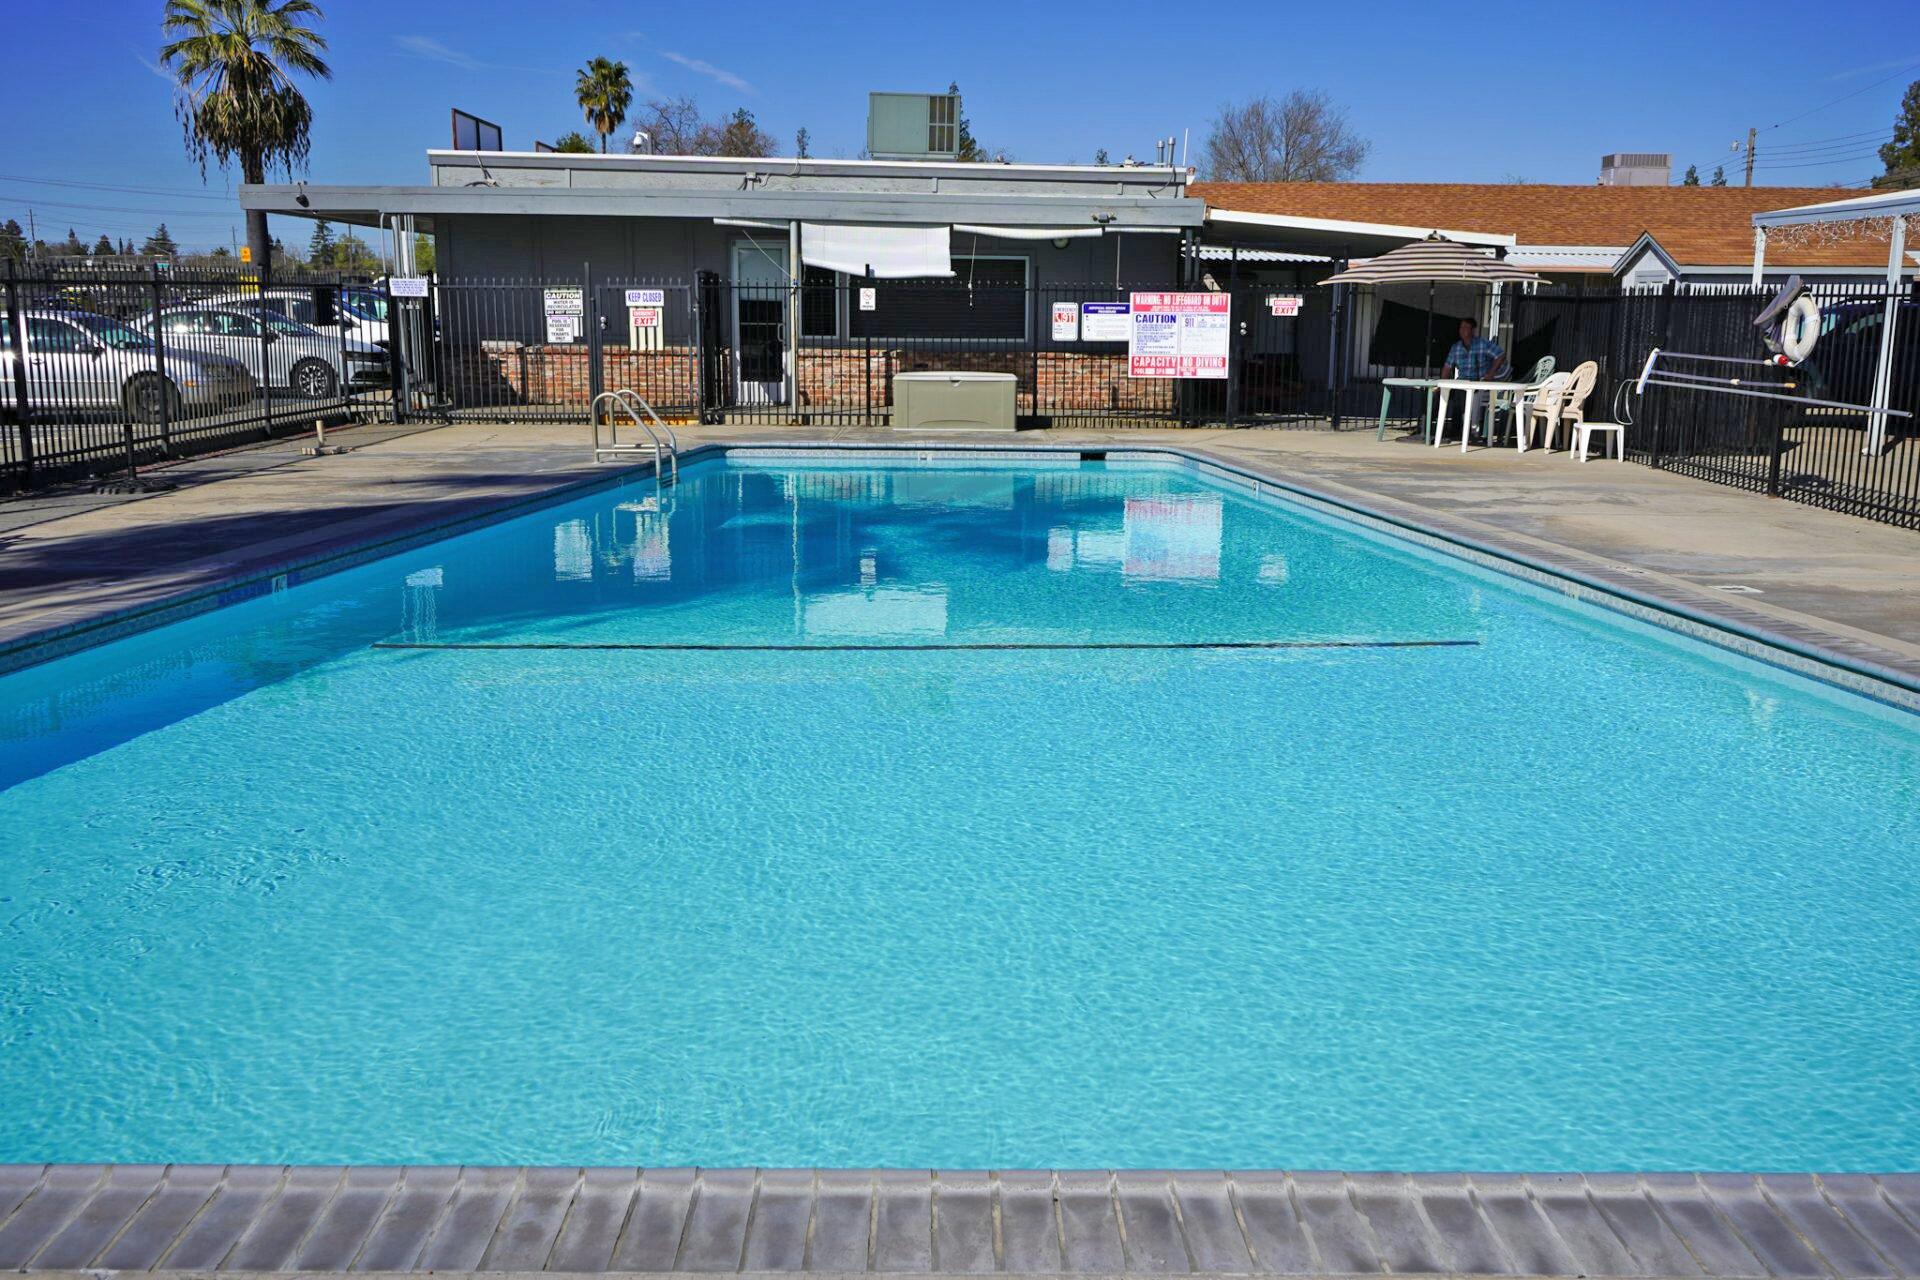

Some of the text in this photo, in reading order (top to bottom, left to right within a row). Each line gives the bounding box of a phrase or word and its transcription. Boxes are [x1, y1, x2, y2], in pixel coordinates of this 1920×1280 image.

[628, 292, 662, 302] KEEP CLOSED
[1163, 294, 1171, 305] NO
[1172, 294, 1202, 305] LIFEGUARD
[1211, 295, 1227, 306] DUTY
[634, 317, 656, 325] EXIT
[1135, 314, 1177, 324] CAUTION
[1185, 317, 1195, 327] 911
[1133, 356, 1177, 367] CAPACITY
[1182, 357, 1223, 368] NO DIVING
